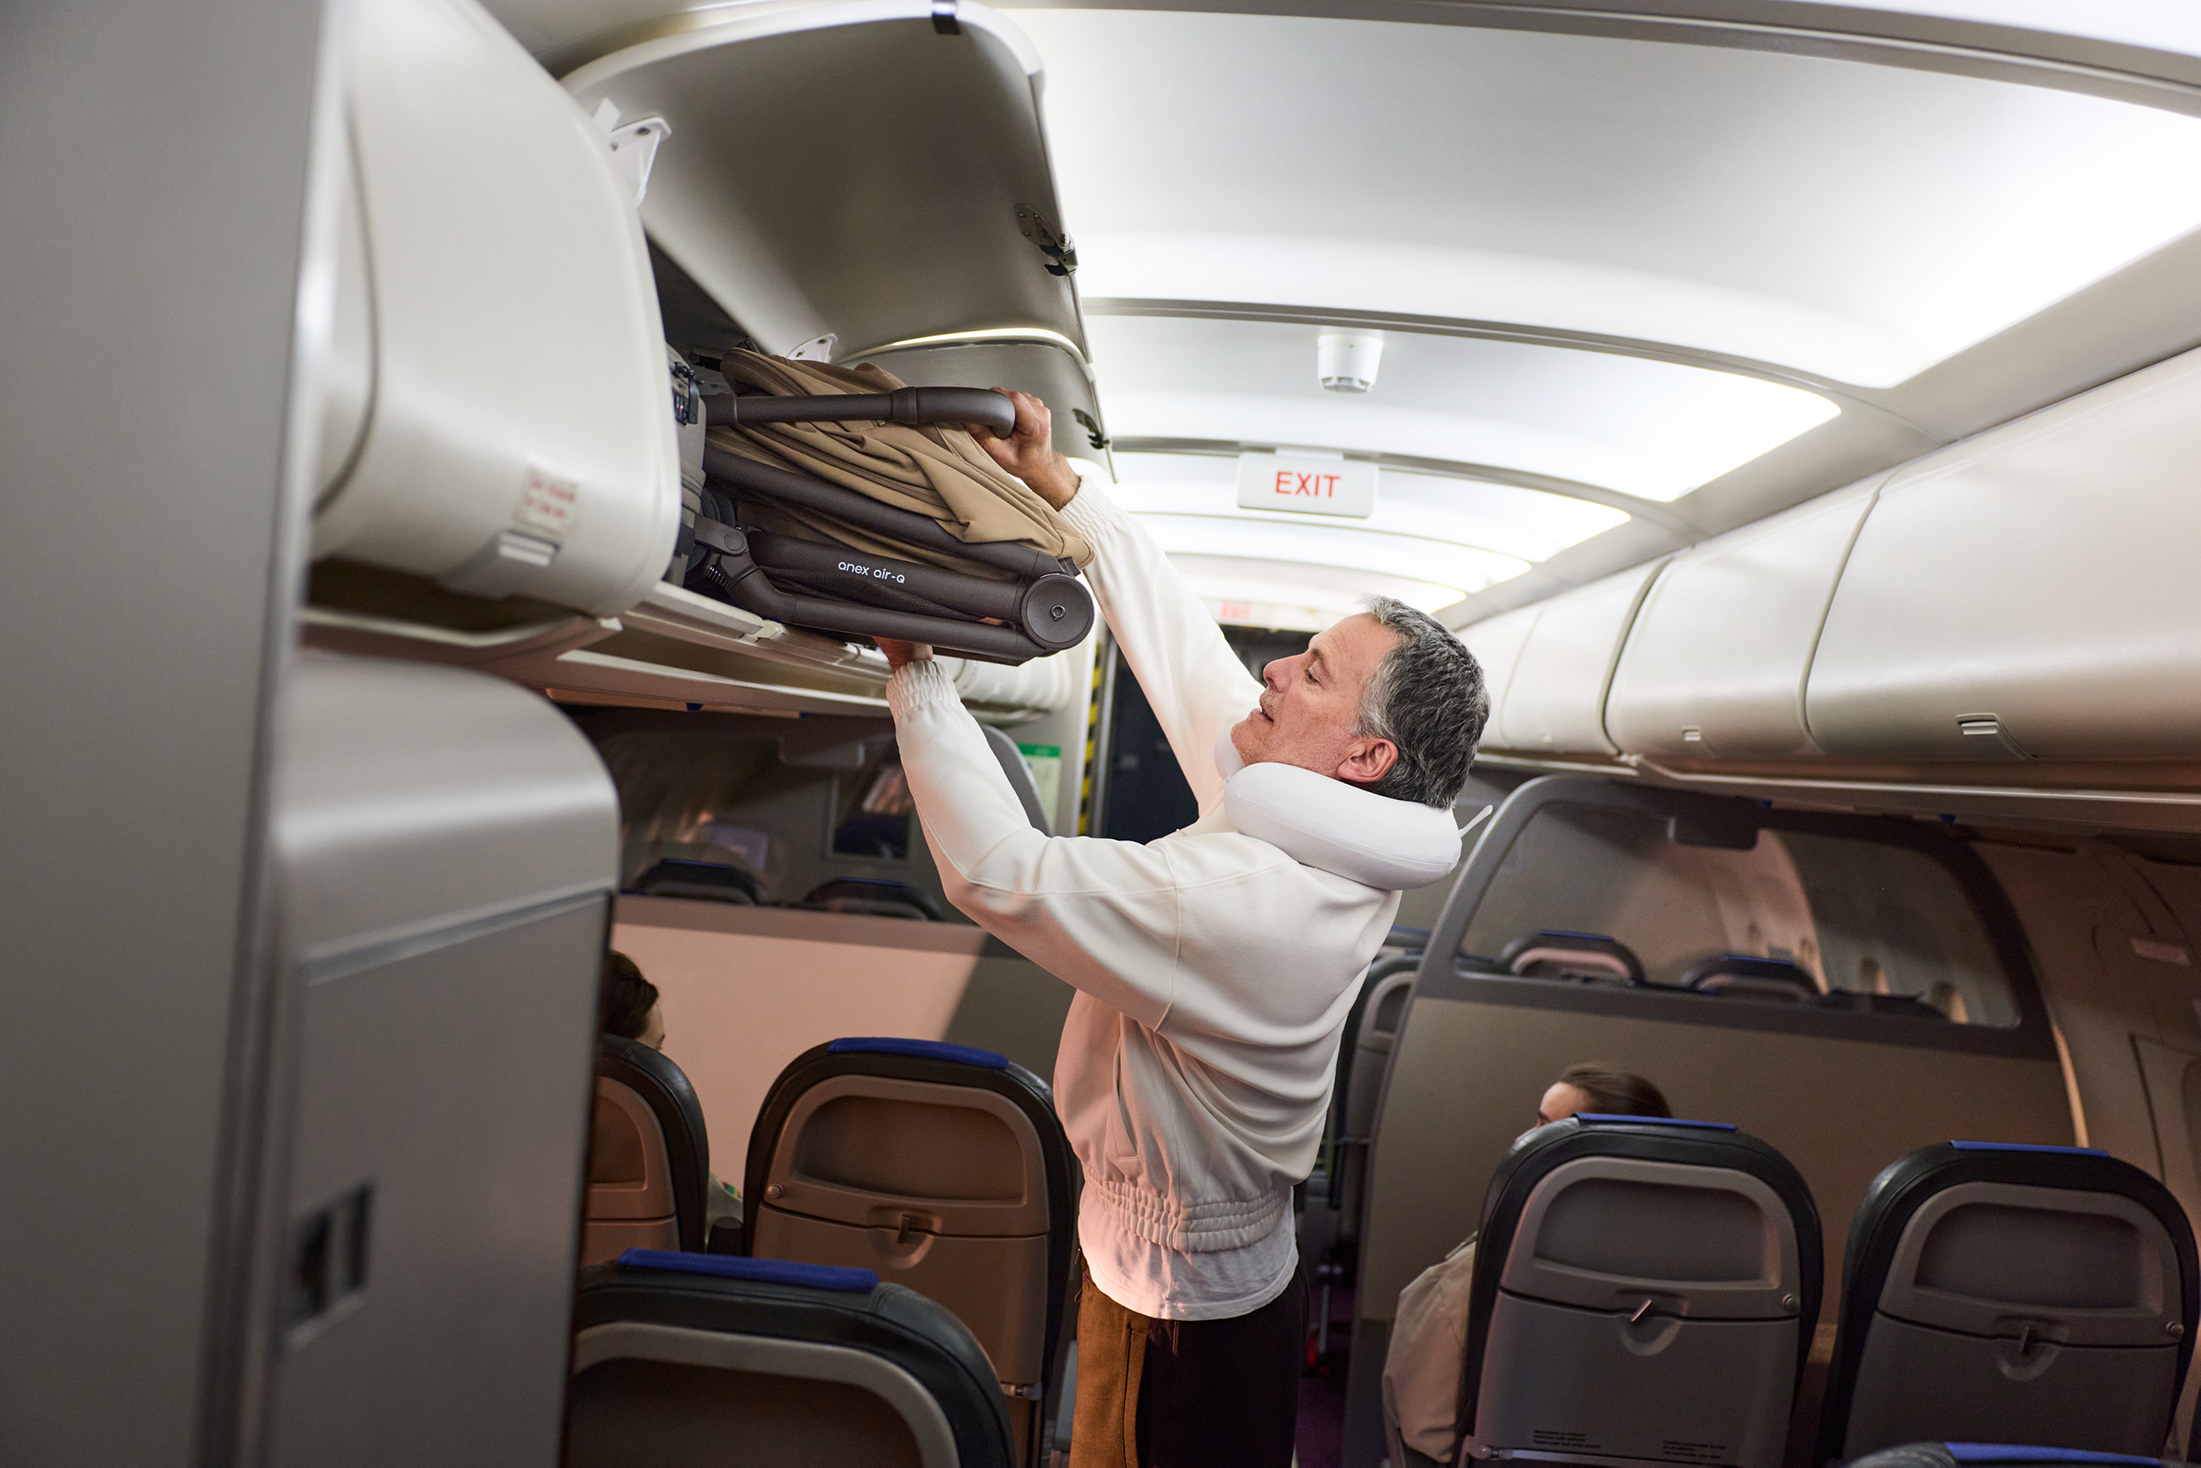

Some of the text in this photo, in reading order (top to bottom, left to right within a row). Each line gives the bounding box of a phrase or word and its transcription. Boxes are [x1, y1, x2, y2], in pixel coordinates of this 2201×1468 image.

[1275, 471, 1341, 498] EXIT
[838, 561, 905, 584] anex air-Q
